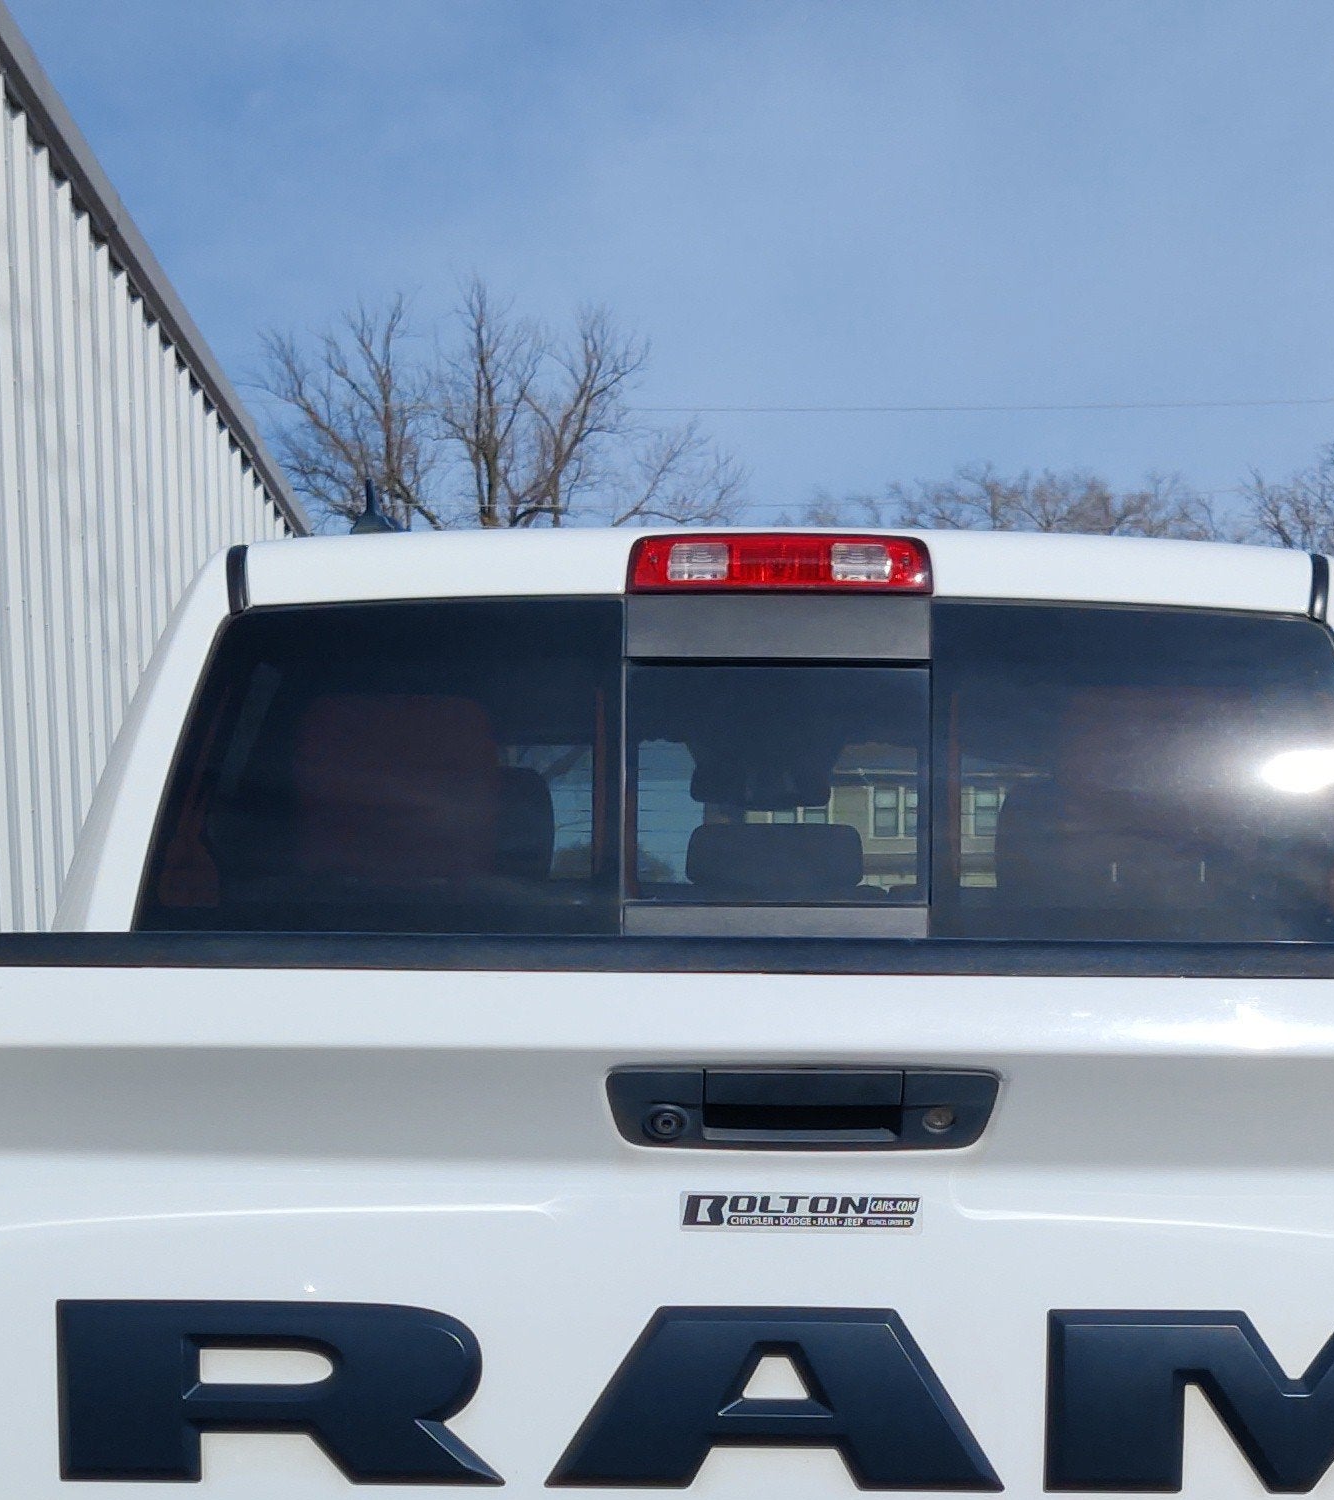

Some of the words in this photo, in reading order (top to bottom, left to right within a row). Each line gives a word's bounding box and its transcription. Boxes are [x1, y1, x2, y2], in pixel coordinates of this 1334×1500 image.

[682, 1194, 870, 1226] BOLTON
[730, 1216, 774, 1226] CHRYSLER
[779, 1216, 812, 1226] DODGE
[817, 1217, 838, 1226] RAM
[843, 1217, 864, 1227] JEEP
